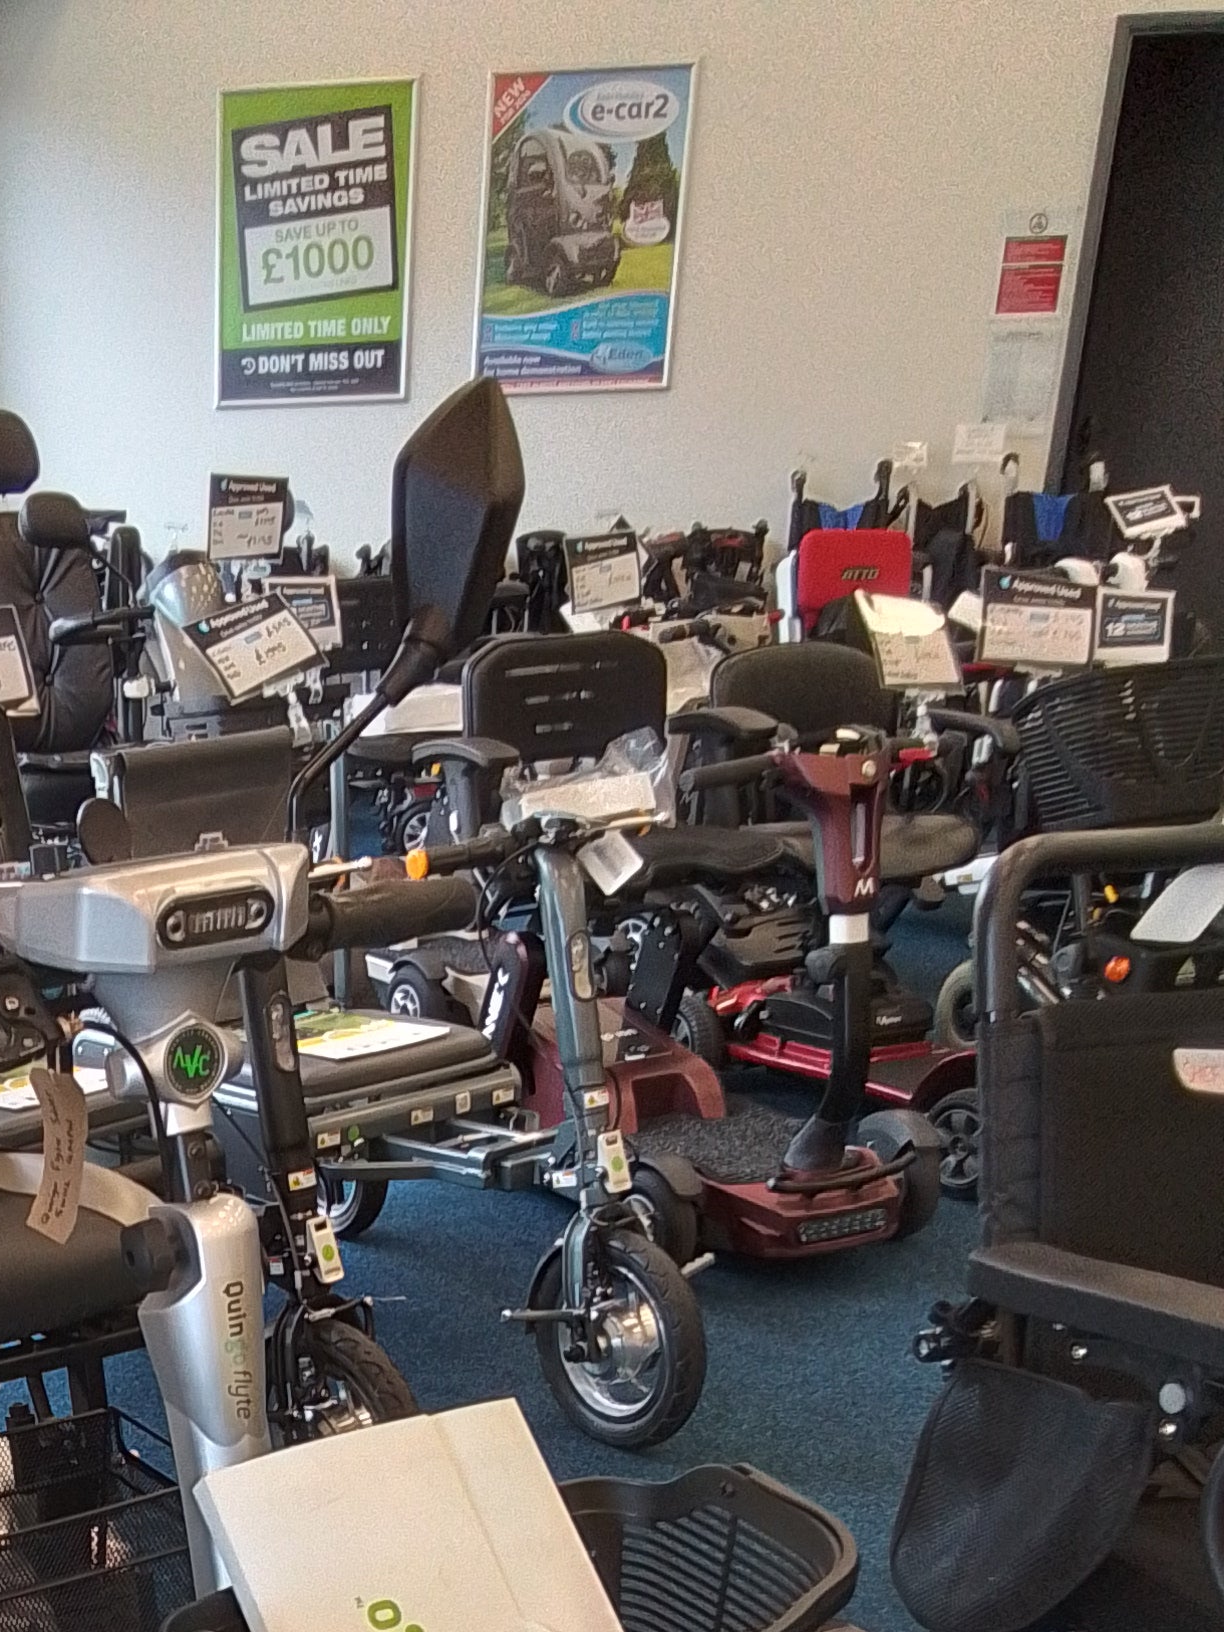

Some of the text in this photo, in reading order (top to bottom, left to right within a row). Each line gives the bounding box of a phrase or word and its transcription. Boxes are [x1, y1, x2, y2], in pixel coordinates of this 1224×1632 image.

[590, 93, 669, 122] e-car2
[239, 114, 386, 179] SALE
[243, 163, 388, 202] LIMITED TIME
[268, 187, 366, 218] SAVINGS
[275, 218, 359, 244] SAVE UP TO
[260, 235, 376, 286] £1000
[241, 315, 392, 343] LIMITED TIME ONLY
[257, 348, 385, 375] DON'T MISS OUT
[222, 1280, 253, 1420] Quingo flyte
